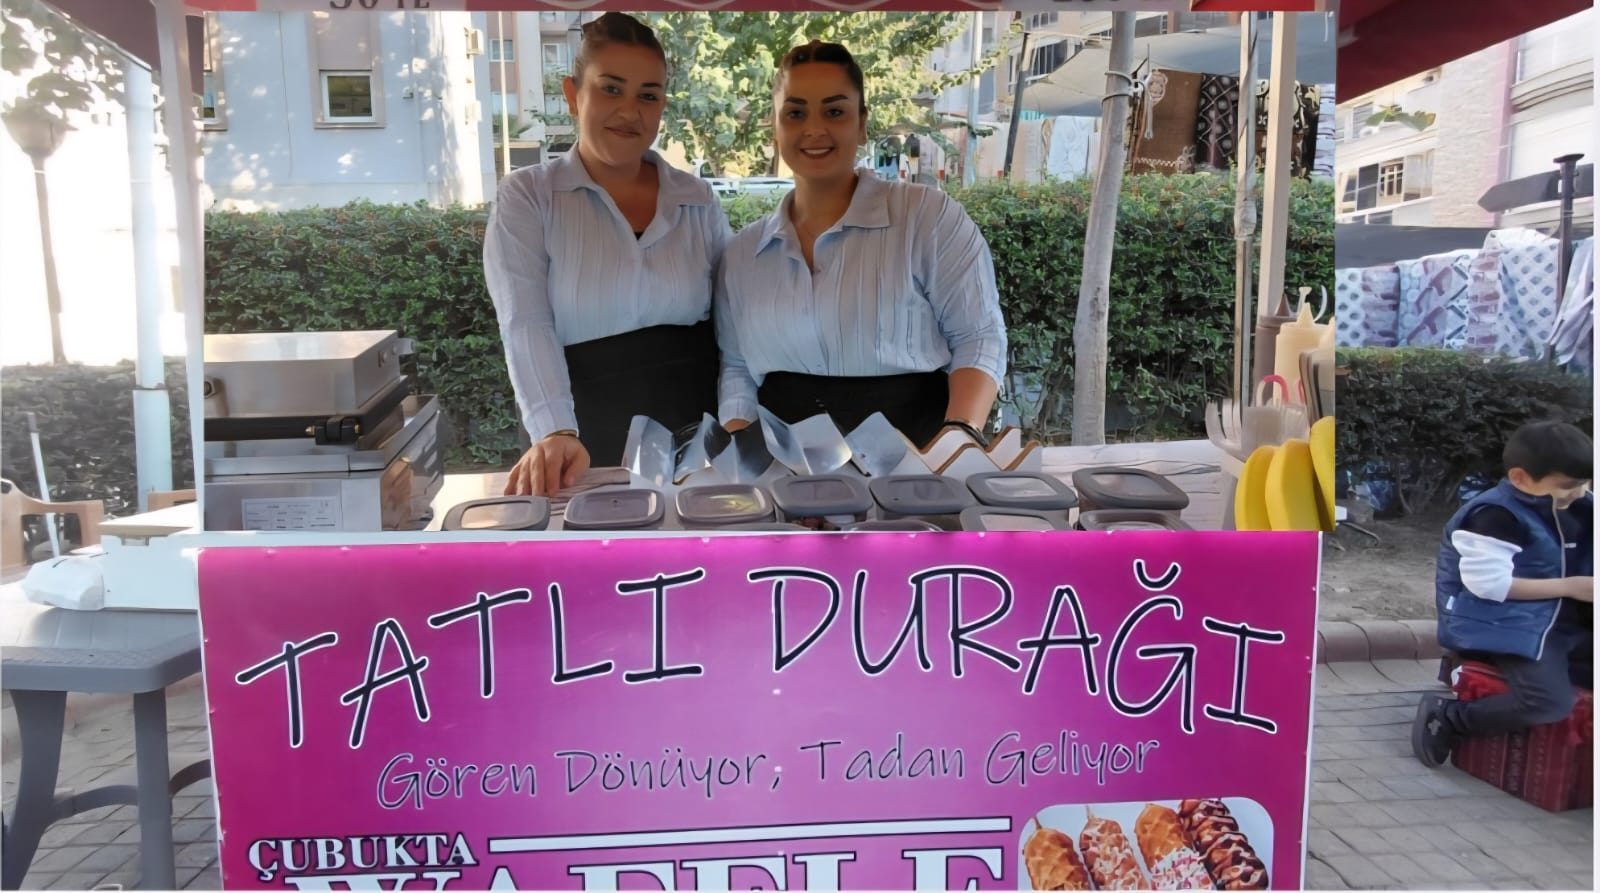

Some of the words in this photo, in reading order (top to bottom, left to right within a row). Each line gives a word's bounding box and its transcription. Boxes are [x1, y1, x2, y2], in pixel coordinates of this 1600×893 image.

[236, 567, 705, 749] TATLI
[748, 559, 1285, 733] DURAĞI
[377, 752, 537, 810] Gören
[800, 734, 965, 783] Tadan
[985, 731, 1160, 787] Geliyor
[248, 832, 478, 881] ÇUBUKTA
